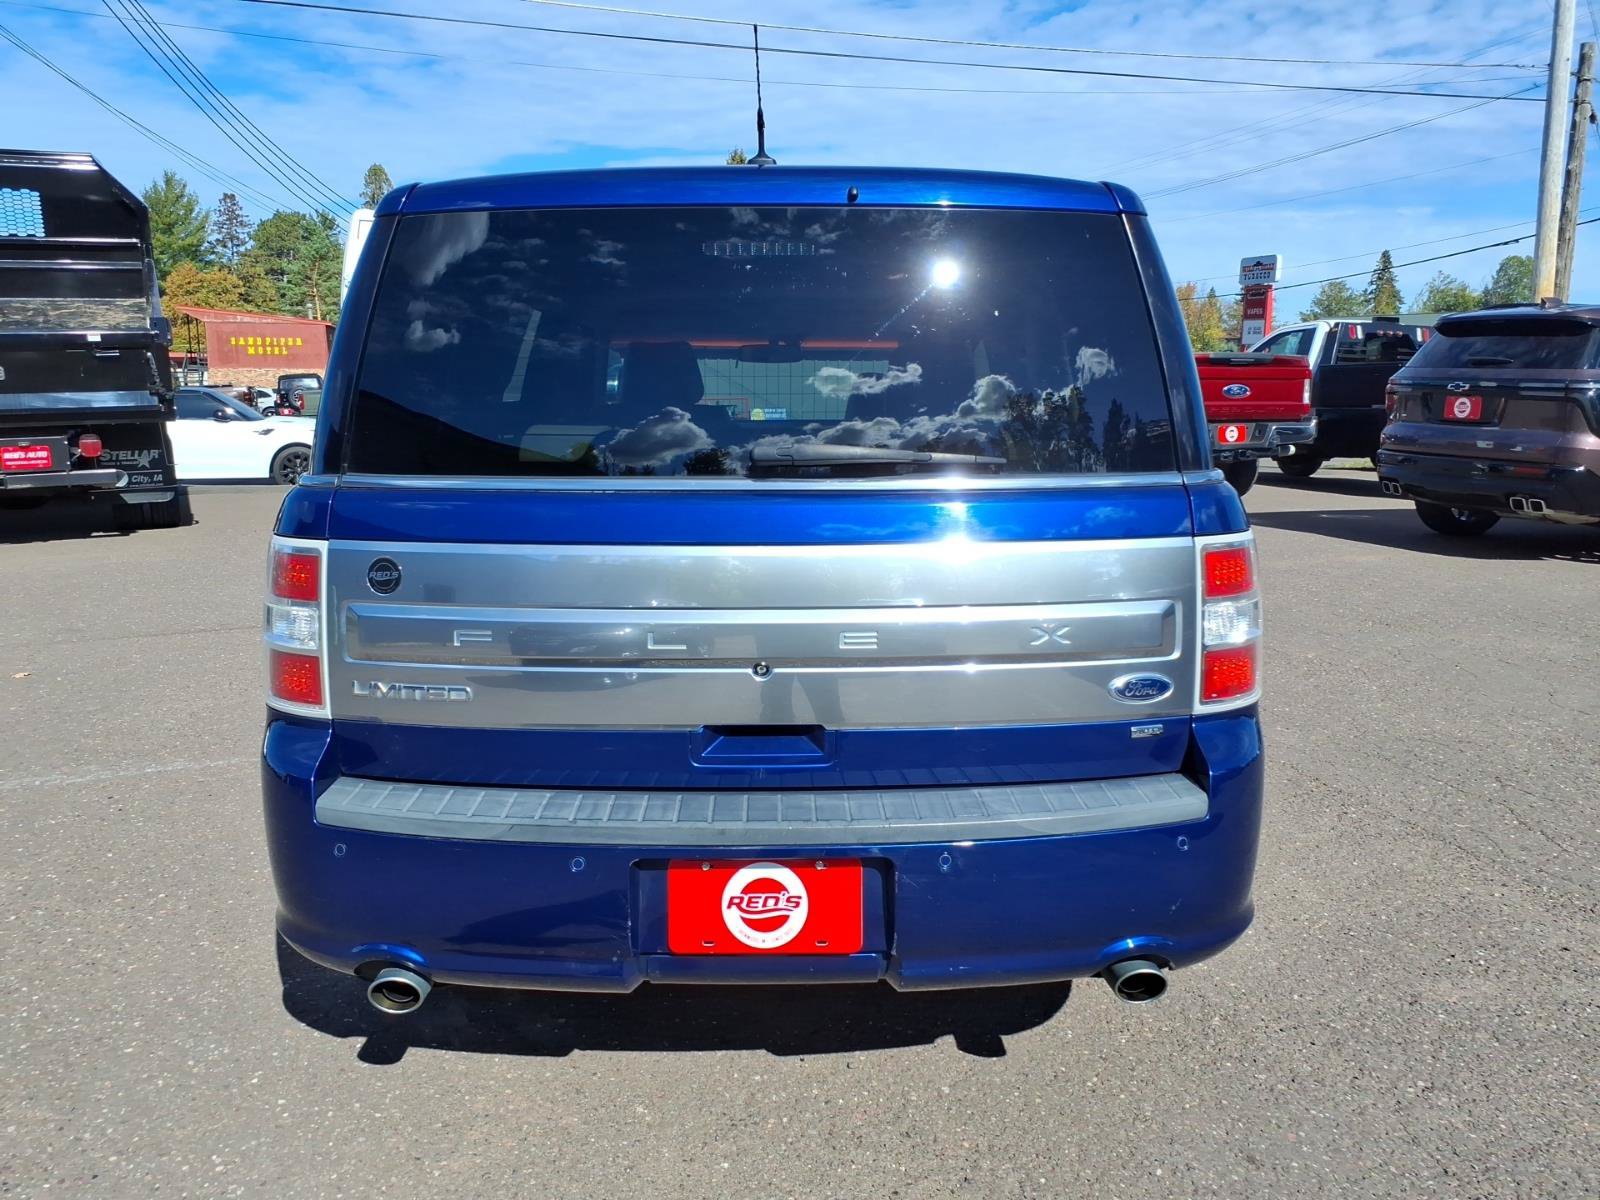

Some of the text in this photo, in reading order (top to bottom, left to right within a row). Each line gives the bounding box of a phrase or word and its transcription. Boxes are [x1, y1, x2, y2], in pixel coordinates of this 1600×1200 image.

[1243, 271, 1271, 281] TOBACCO
[230, 336, 303, 346] SANDPIPER
[247, 346, 288, 355] MOTEL
[26, 450, 48, 458] AUTO
[100, 449, 160, 461] STELLAR
[131, 473, 163, 483] City, IA
[453, 625, 1072, 650] FLEX
[351, 679, 474, 702] LIMITED
